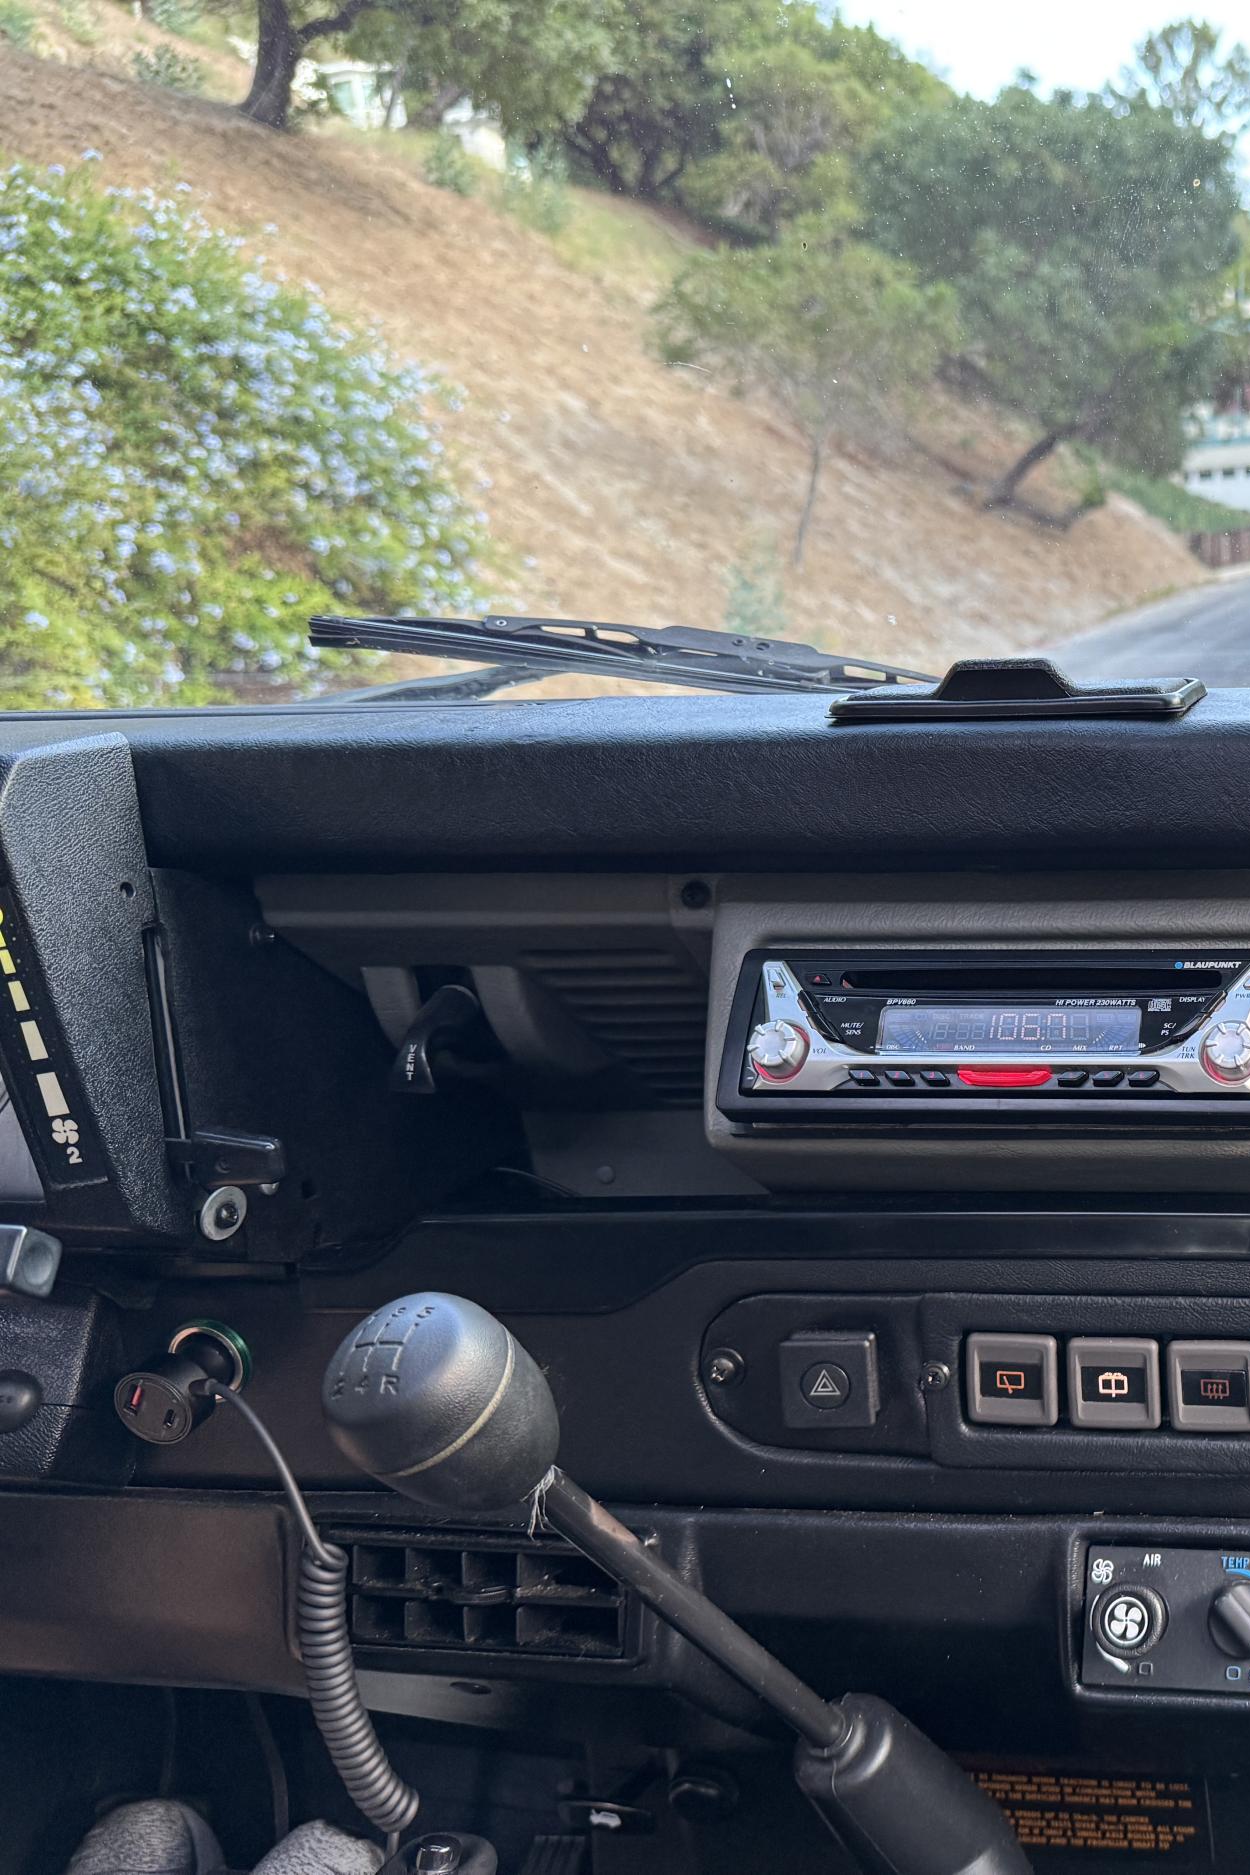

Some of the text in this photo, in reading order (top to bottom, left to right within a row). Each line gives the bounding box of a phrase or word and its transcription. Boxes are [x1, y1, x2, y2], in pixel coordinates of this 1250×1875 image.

[1183, 961, 1242, 969] BLAUPUNKT
[990, 1013, 1067, 1040] 106.7
[406, 1044, 418, 1081] VENT
[380, 1374, 399, 1395] R
[1143, 1553, 1162, 1567] AIR
[1221, 1556, 1250, 1568] TEMP
